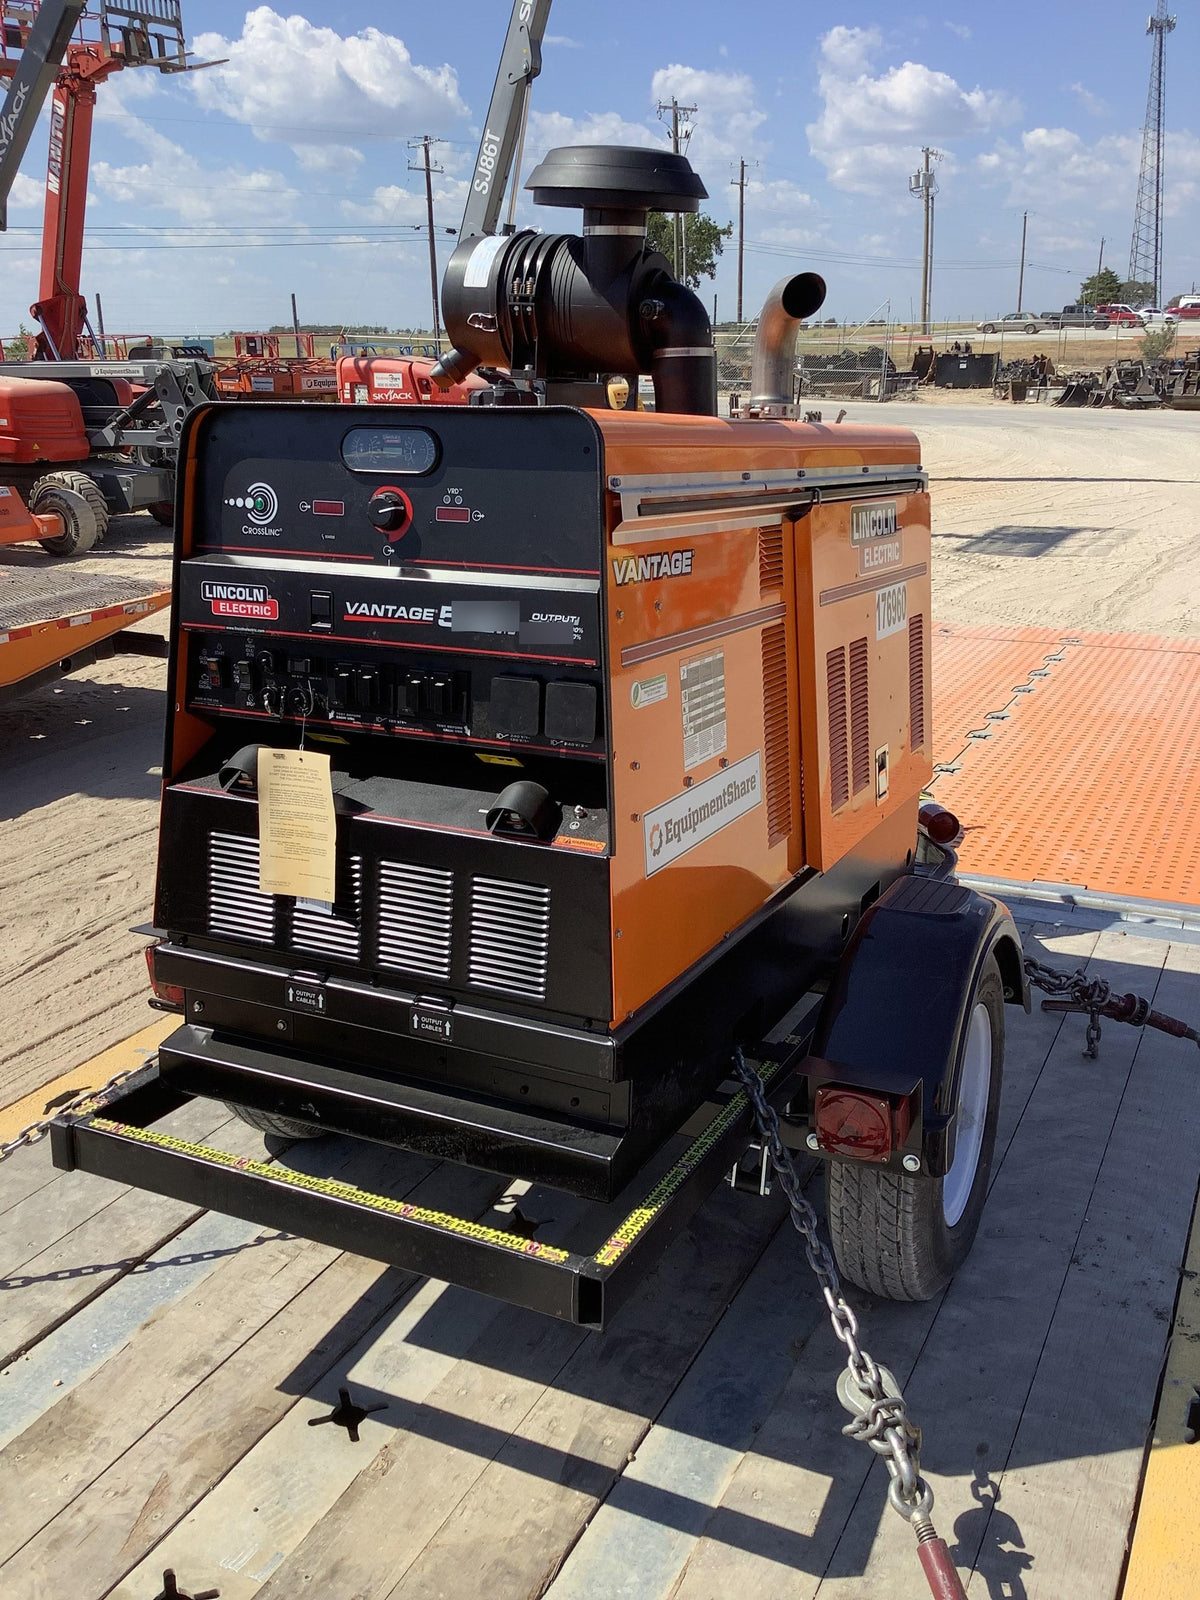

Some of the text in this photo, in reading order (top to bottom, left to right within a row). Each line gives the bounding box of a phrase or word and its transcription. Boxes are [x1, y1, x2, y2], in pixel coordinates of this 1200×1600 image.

[47, 98, 66, 195] MANITOU
[474, 129, 501, 195] SJ86T
[372, 390, 414, 402] SKYJACK
[853, 508, 896, 540] LINCOLN
[613, 550, 693, 586] VANTAGE
[864, 542, 900, 568] ELECTRIC
[205, 584, 264, 602] LINCOLN
[219, 602, 272, 616] ELECTRIC
[345, 601, 436, 621] VANTAGE
[531, 612, 577, 624] OUTPUT
[876, 585, 907, 631] 176960
[665, 774, 757, 845] EquipmentShare
[295, 989, 316, 999] OUTPUT
[295, 996, 316, 1006] CABLES
[421, 1015, 443, 1026] OUTPUT
[421, 1023, 442, 1033] CABLES
[124, 1127, 234, 1163] DO NOT STAND HERE
[248, 1162, 399, 1210] NE PAS TENEZ DEBOUT ICI
[415, 1210, 435, 1219] NO
[436, 1215, 456, 1226] SE
[455, 1222, 491, 1236] PARE
[620, 1227, 634, 1240] DO
[631, 1211, 649, 1227] NOT
